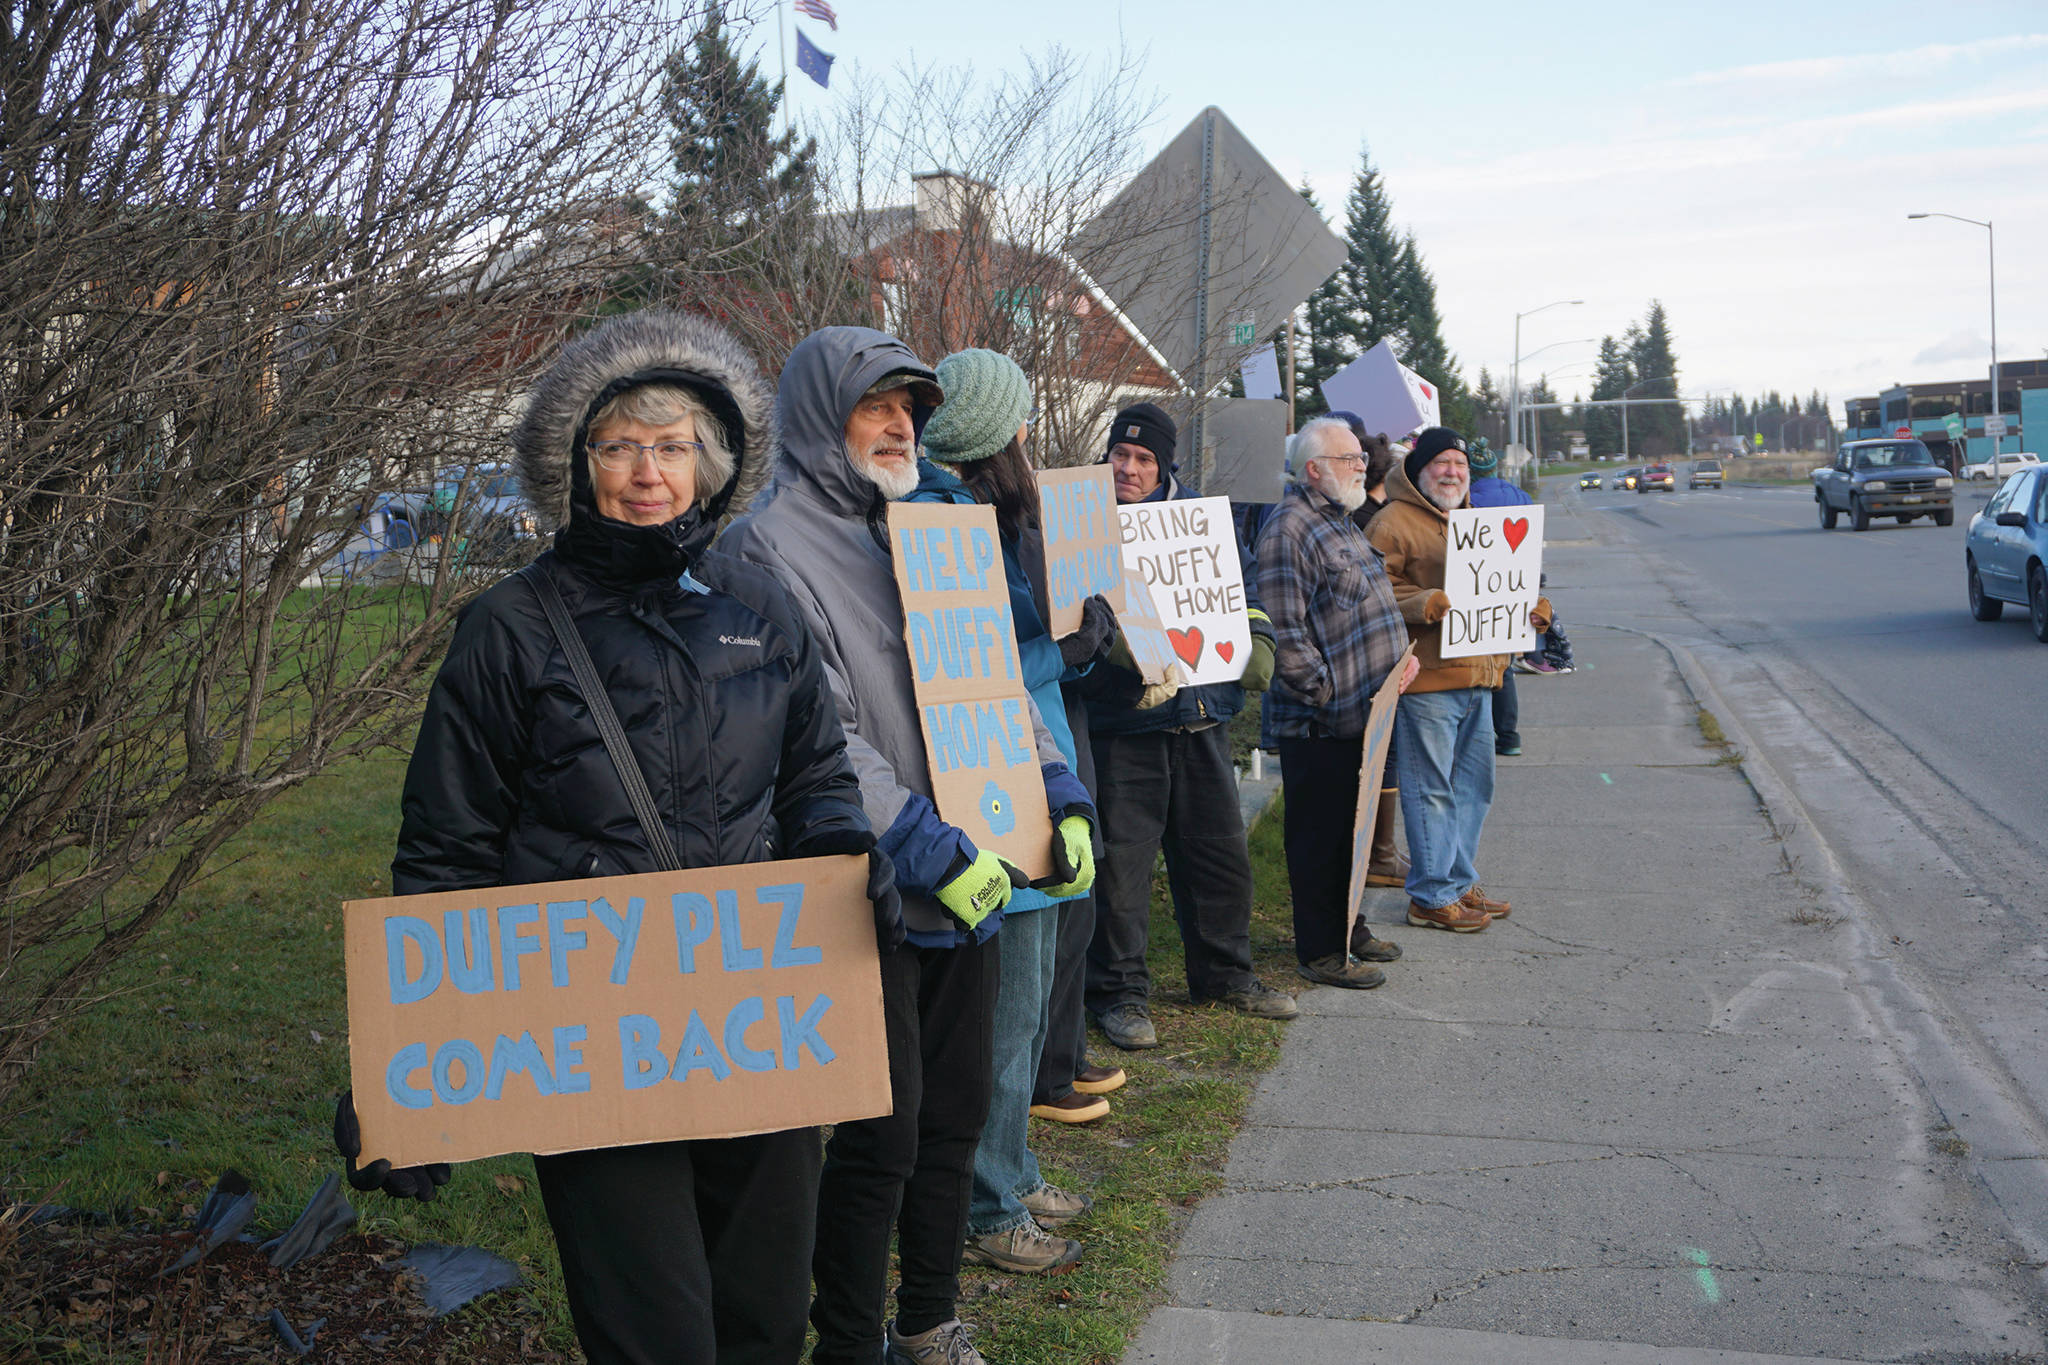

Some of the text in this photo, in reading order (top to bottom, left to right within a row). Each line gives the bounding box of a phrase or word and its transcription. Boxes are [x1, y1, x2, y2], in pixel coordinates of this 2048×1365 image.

[1042, 478, 1109, 546] DUFFY
[1119, 506, 1209, 544] BRING
[1452, 517, 1494, 551] We
[899, 526, 994, 592] HELP
[1137, 544, 1222, 586] DUFFY
[1468, 559, 1526, 595] You
[1173, 583, 1242, 618] HOME
[727, 635, 761, 647] Columbia
[907, 602, 1016, 683] DUFFY
[1448, 601, 1529, 646] DUFFY!
[925, 699, 1031, 773] HOME
[384, 883, 823, 1005] DUFFY PLZ
[385, 993, 837, 1109] COME BACK
